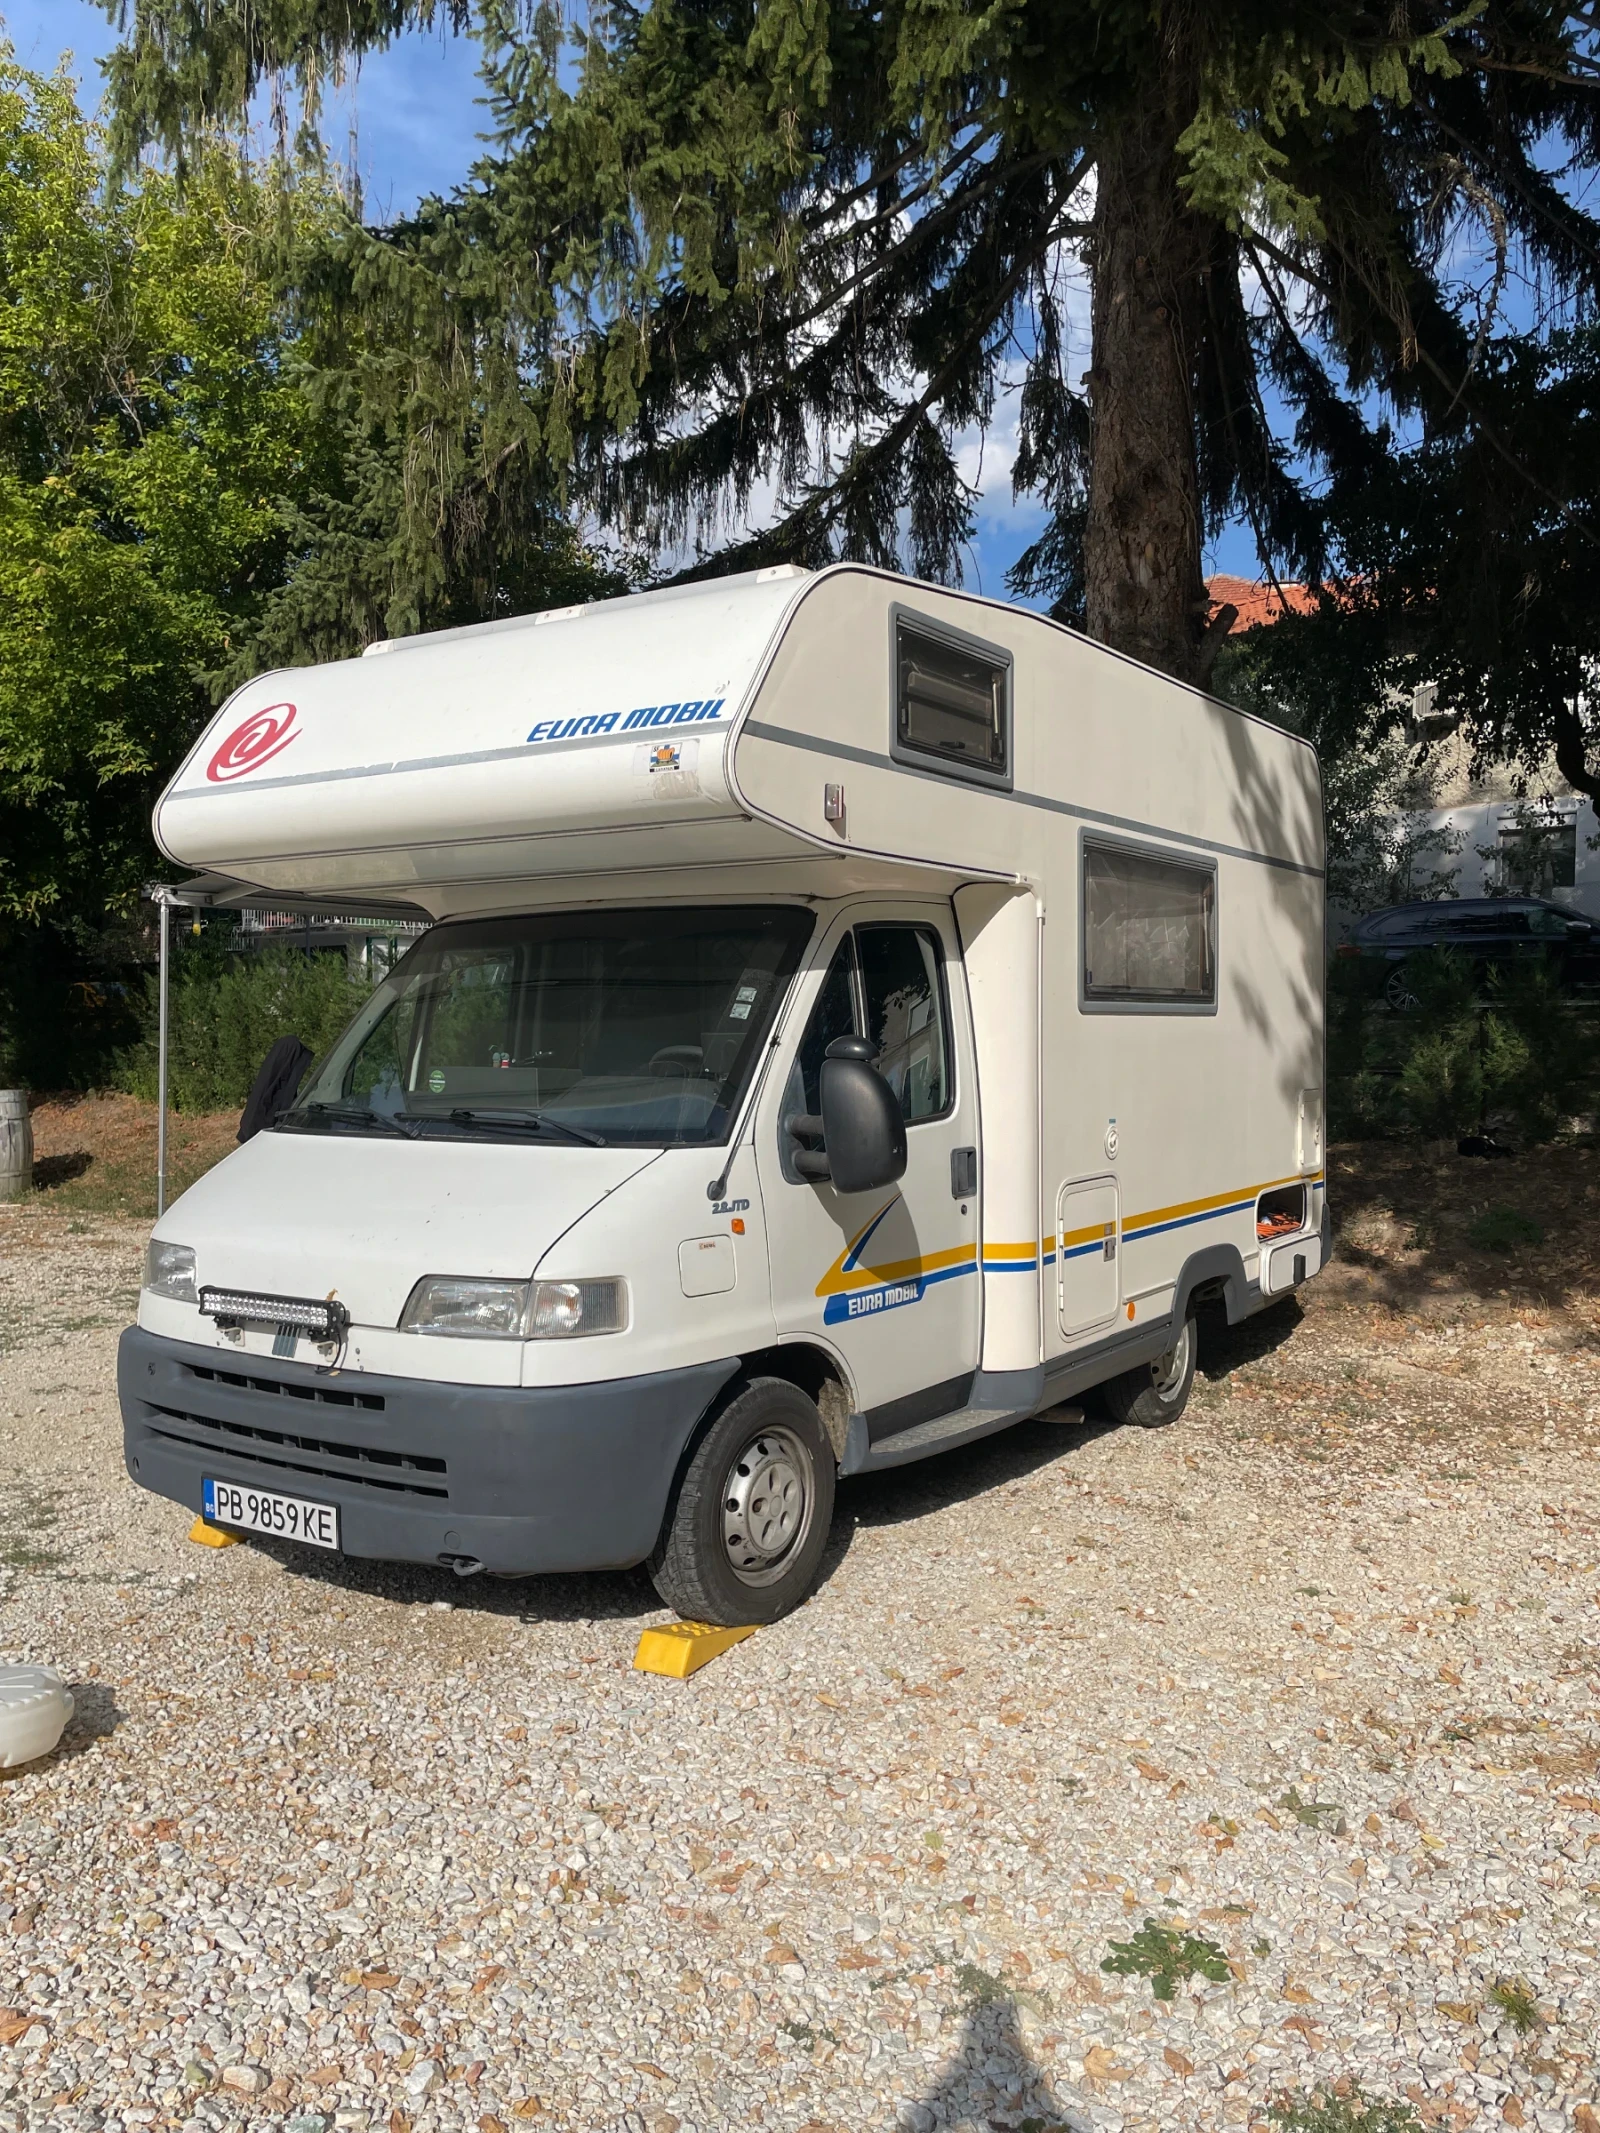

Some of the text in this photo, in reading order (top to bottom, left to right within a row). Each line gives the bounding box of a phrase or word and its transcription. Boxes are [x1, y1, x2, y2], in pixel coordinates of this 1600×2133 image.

[527, 698, 726, 742] EURA MOBIL
[848, 1283, 919, 1316] EURA MOBIL
[205, 1502, 214, 1513] BG
[217, 1486, 333, 1543] PB 9859 KE
